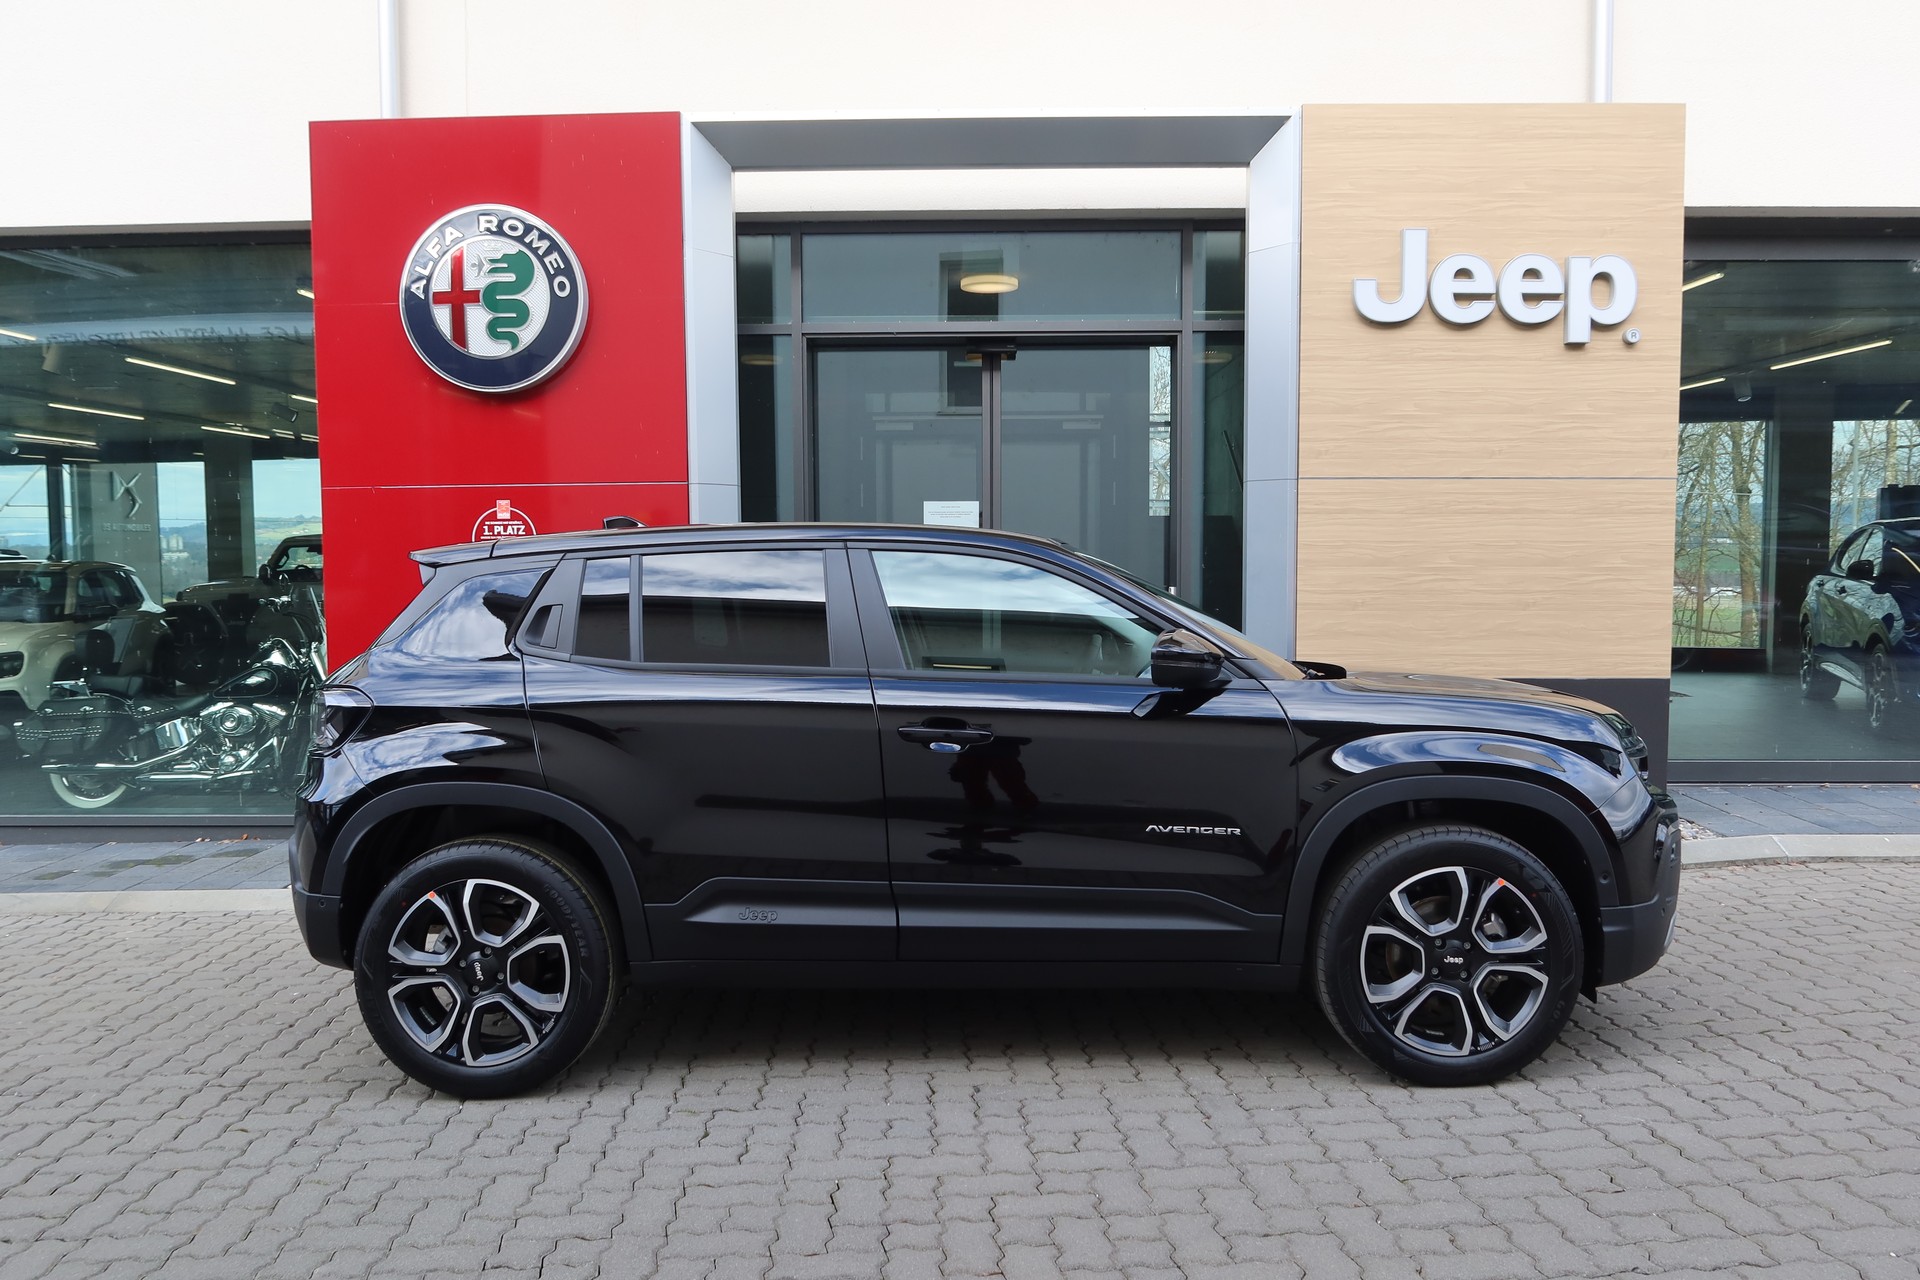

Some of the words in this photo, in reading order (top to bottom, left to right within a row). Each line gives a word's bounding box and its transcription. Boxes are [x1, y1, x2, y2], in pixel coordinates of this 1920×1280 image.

[411, 226, 464, 300] ALFA
[477, 213, 571, 298] ROMEO
[1352, 227, 1638, 345] Jeep
[482, 525, 493, 536] 1.
[493, 525, 526, 536] PLATZ
[1145, 825, 1242, 836] AVENGER
[739, 906, 779, 924] Jeep
